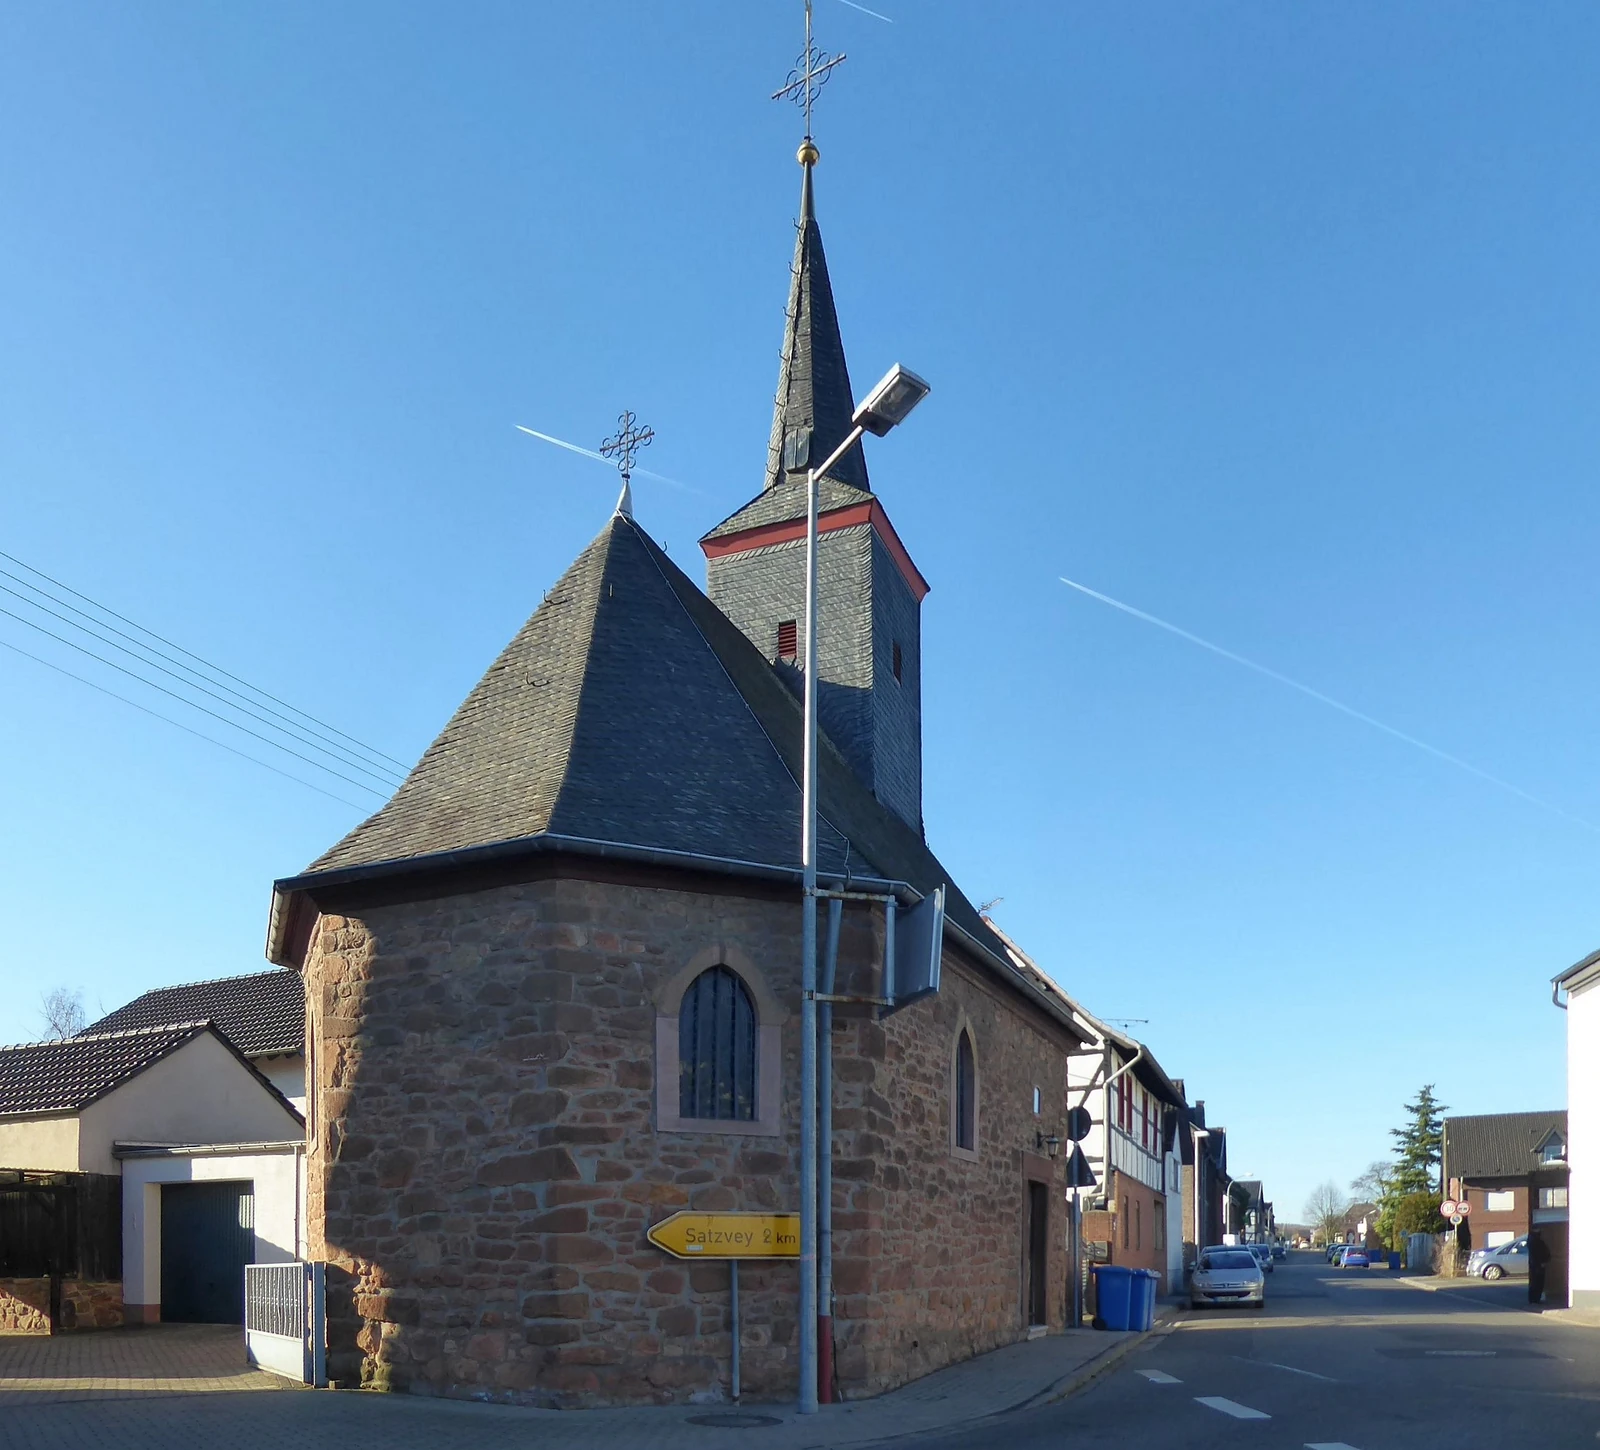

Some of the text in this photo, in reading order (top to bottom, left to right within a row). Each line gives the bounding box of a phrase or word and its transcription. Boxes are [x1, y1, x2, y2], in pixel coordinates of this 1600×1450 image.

[685, 1227, 796, 1248] Satzvey 2 km
